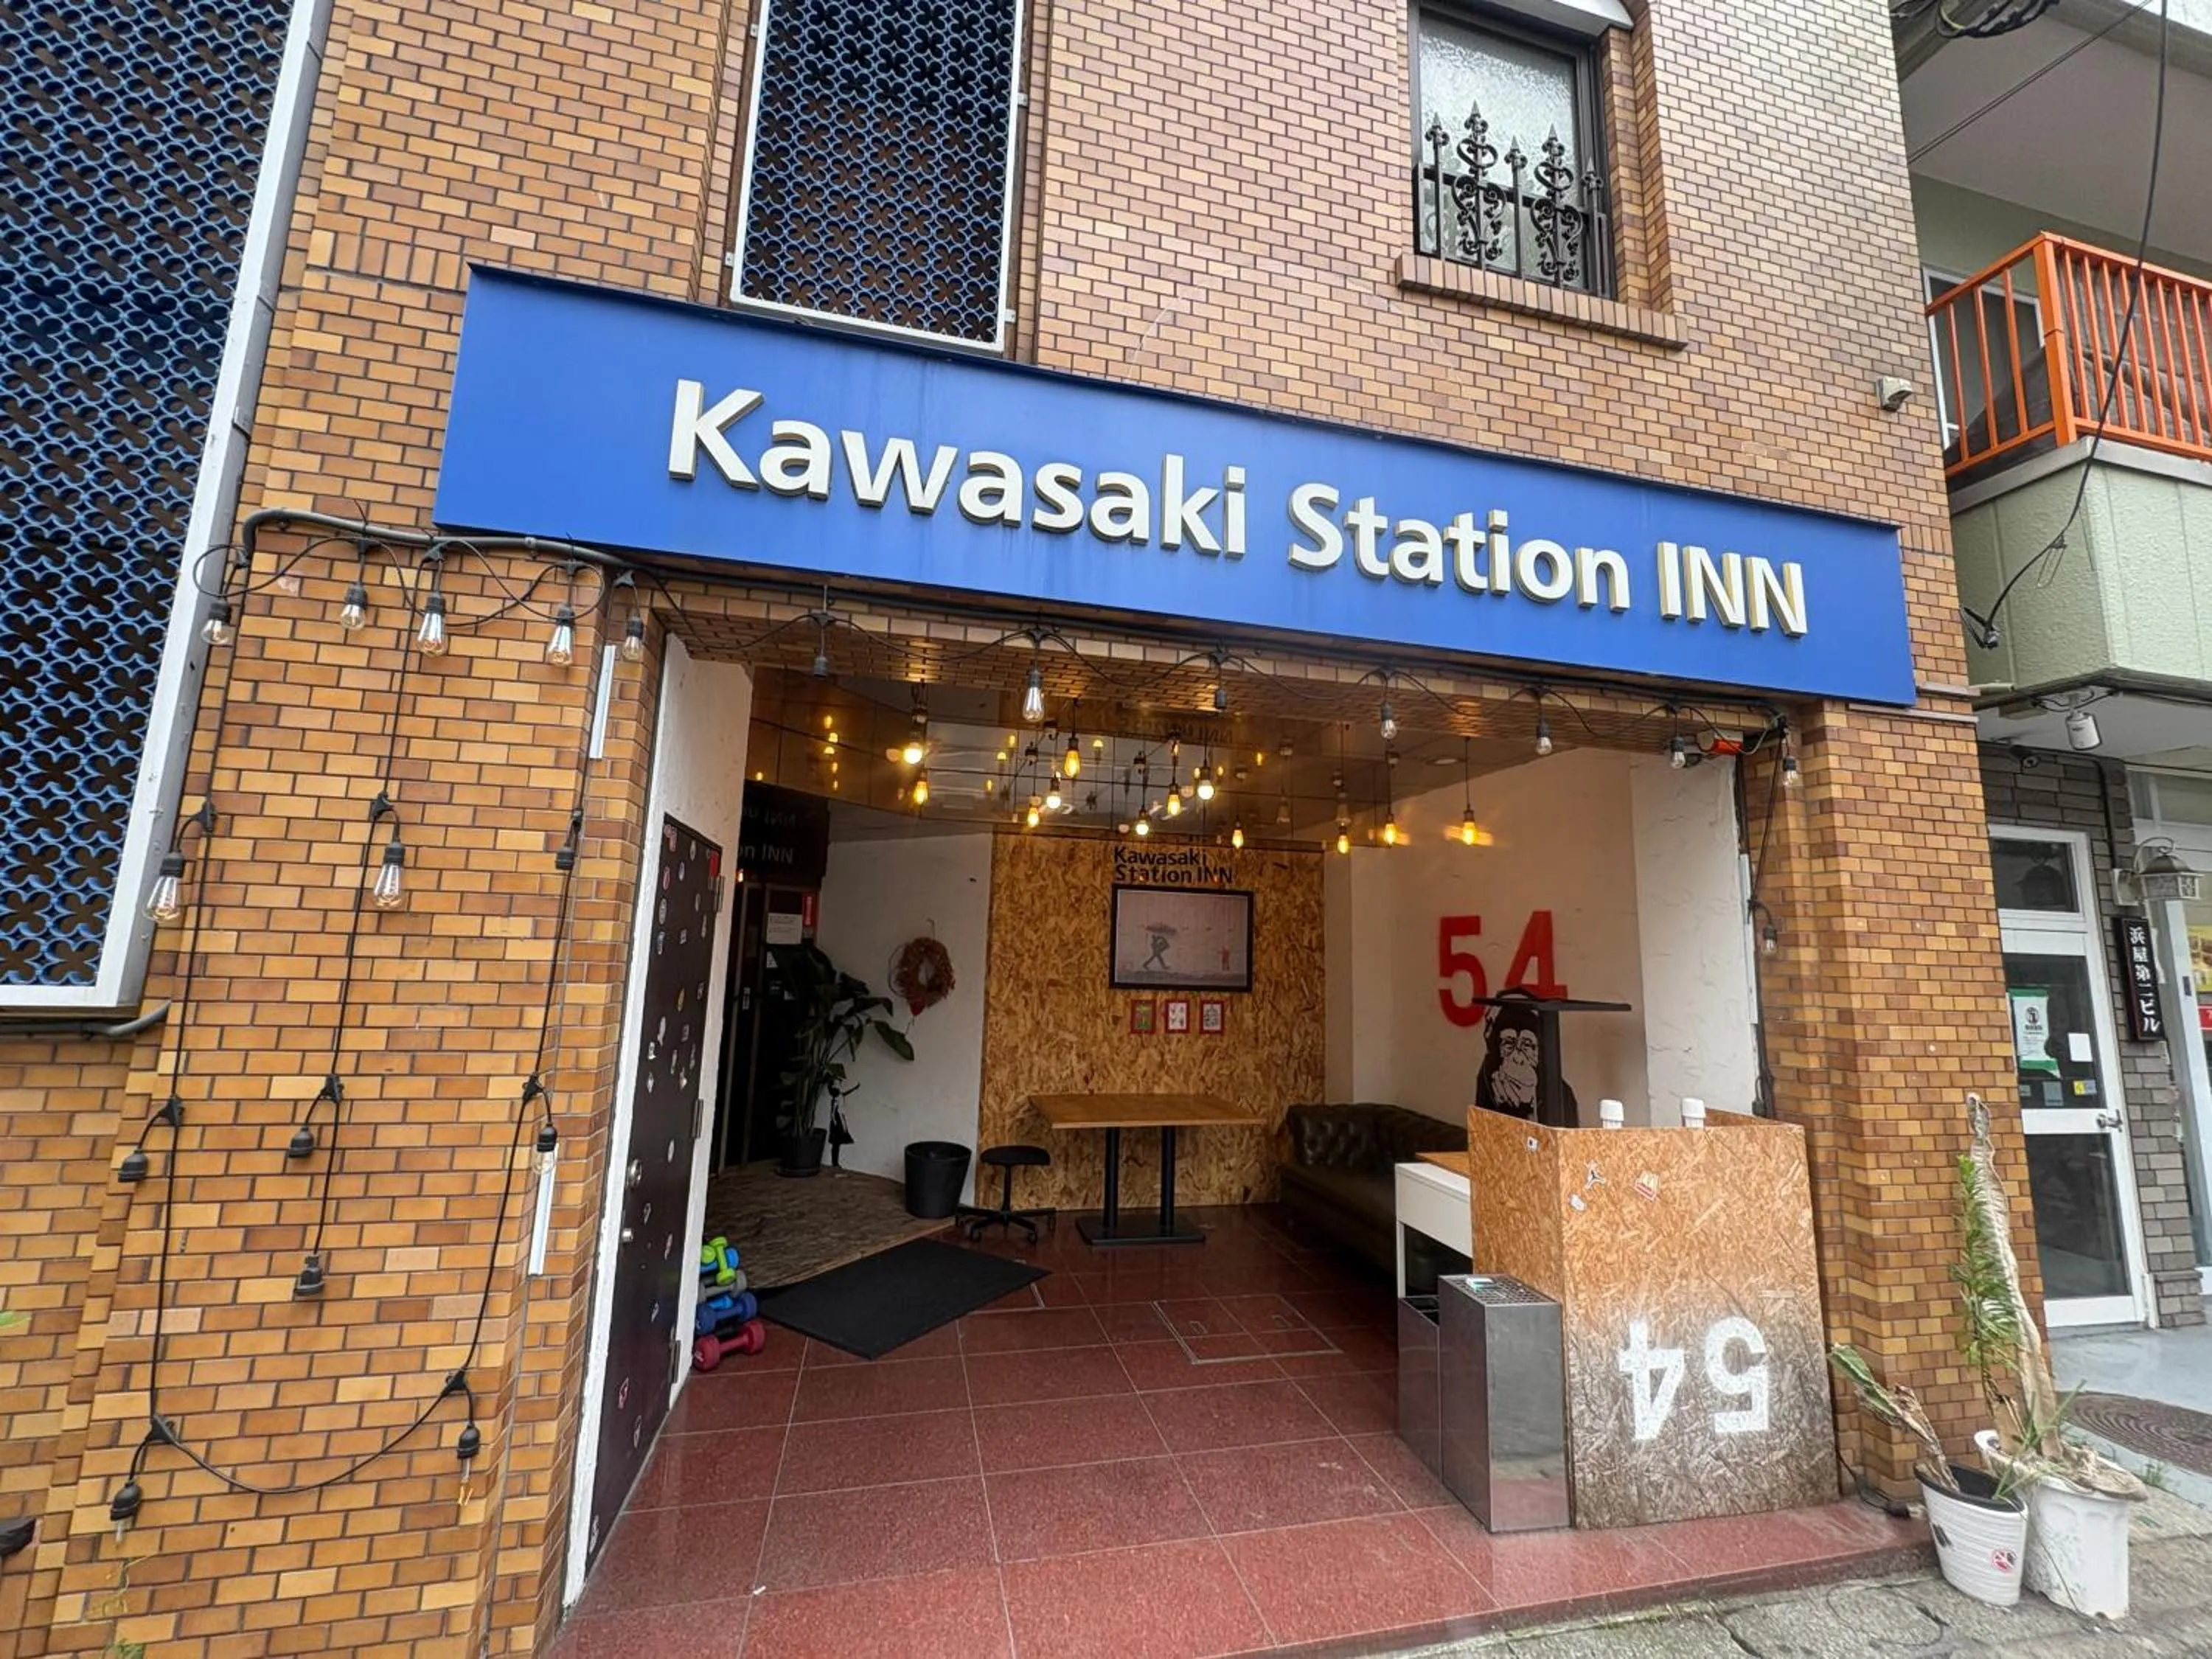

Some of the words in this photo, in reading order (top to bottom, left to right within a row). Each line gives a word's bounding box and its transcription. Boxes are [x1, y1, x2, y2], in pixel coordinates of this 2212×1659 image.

[667, 378, 1247, 558] Kawasaki
[1287, 483, 1630, 613] Station
[1657, 541, 1809, 639] INN
[762, 843, 794, 864] INN
[1113, 846, 1206, 866] Kawasaki
[1114, 864, 1192, 883] Station
[1197, 867, 1233, 883] INN
[1439, 910, 1568, 1027] 54
